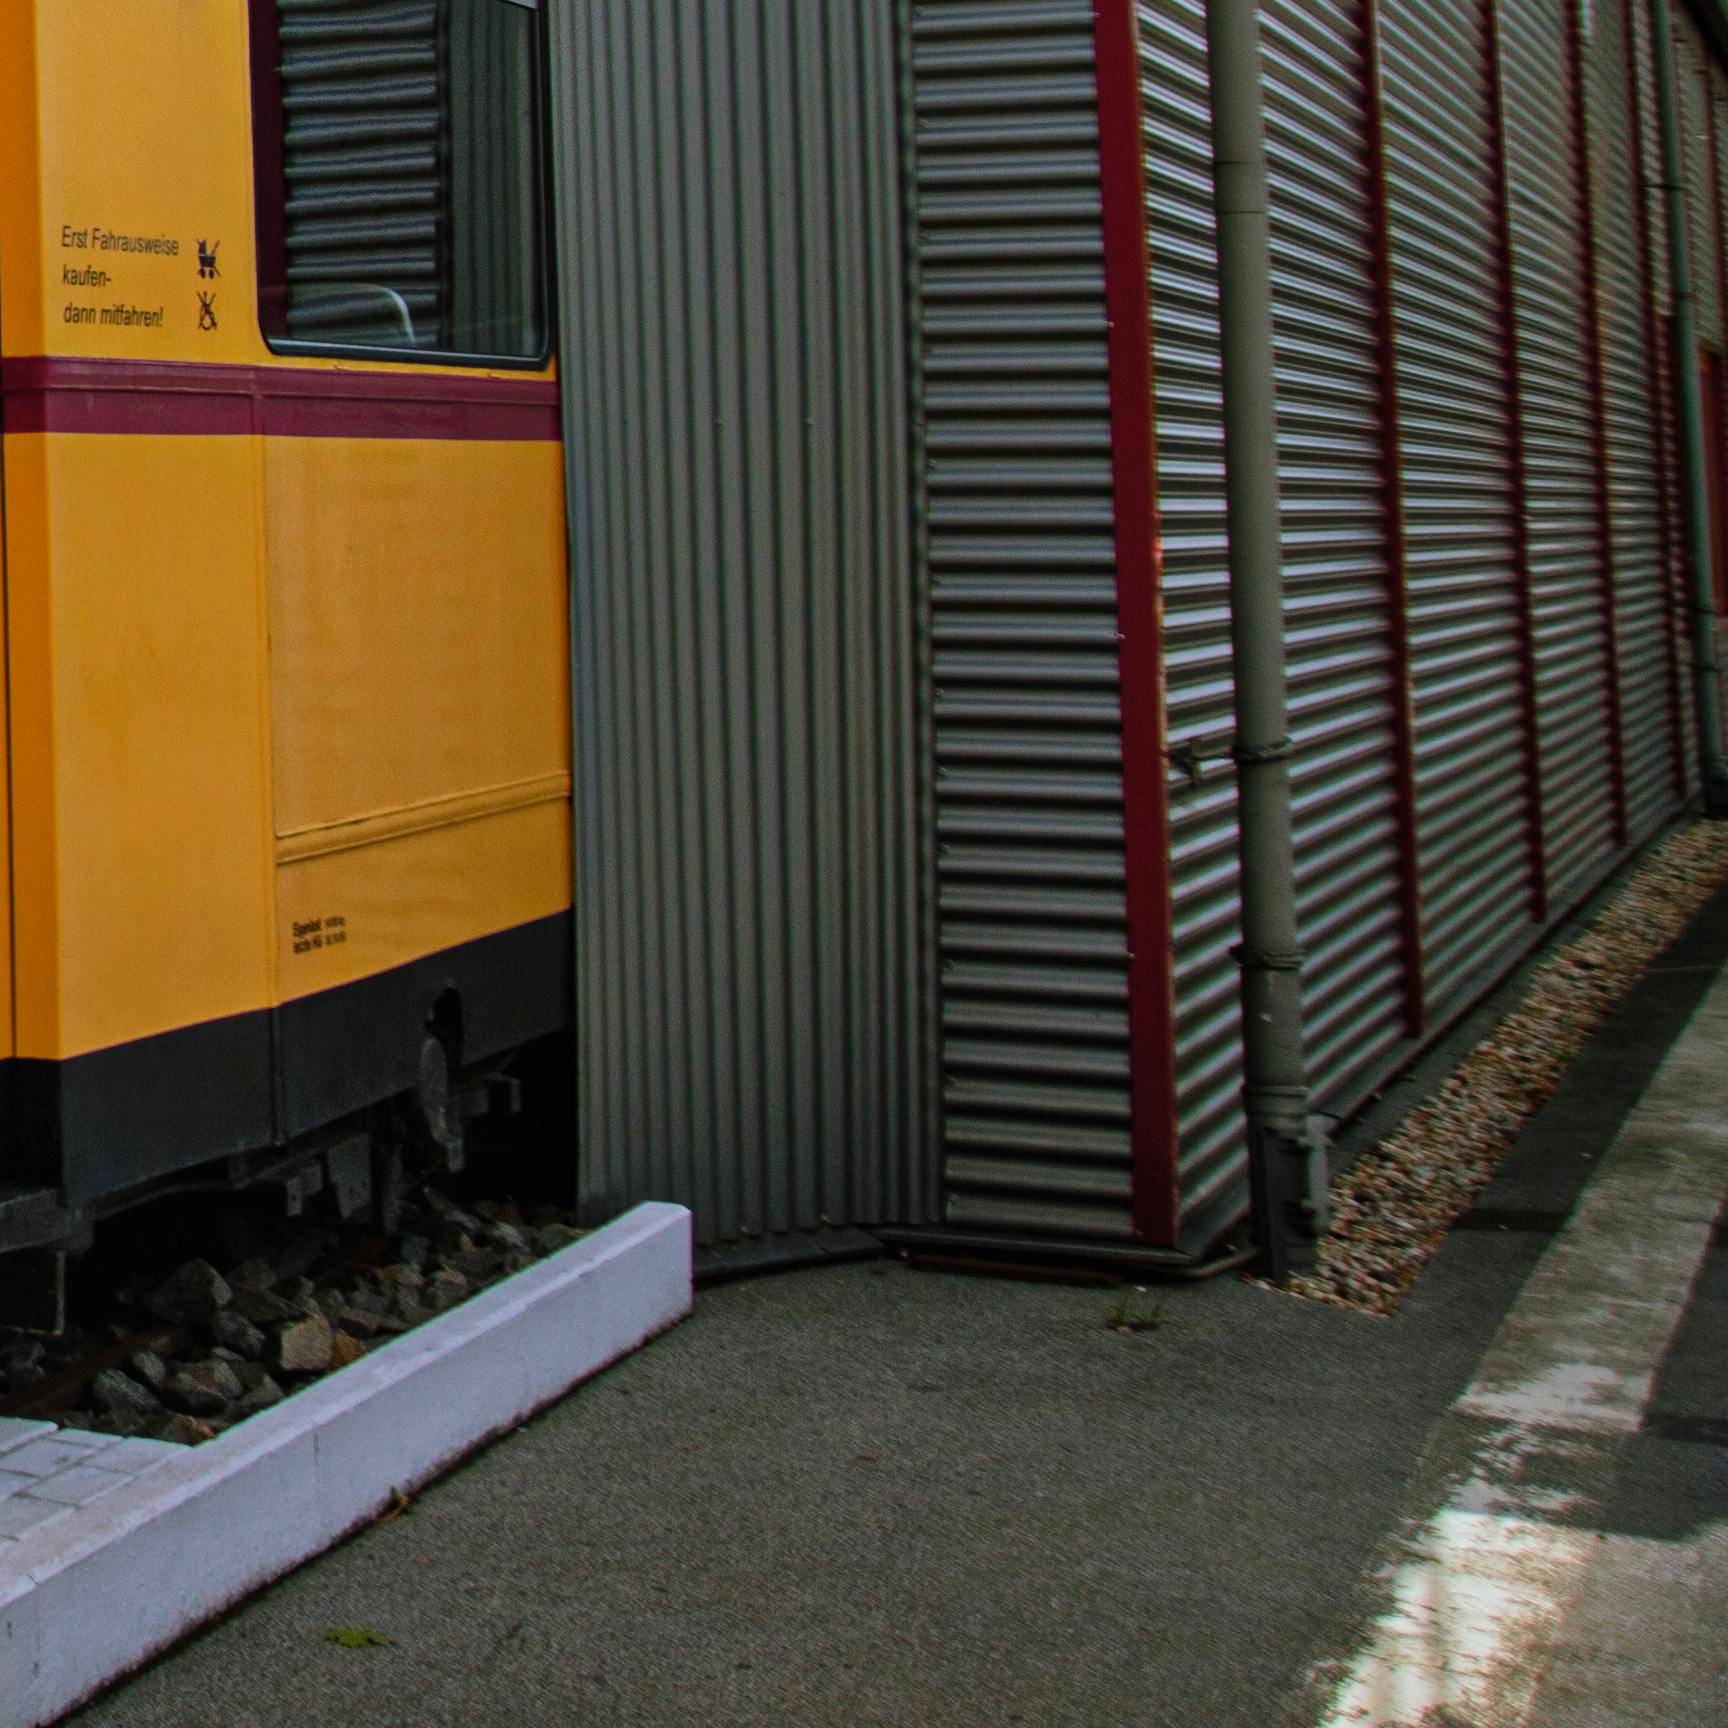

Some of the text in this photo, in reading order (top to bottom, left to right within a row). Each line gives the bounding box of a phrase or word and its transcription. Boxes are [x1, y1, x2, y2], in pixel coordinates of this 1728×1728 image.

[61, 225, 180, 256] Erst Fahrausweise
[62, 263, 112, 287] kaufen-
[64, 301, 96, 323] dann
